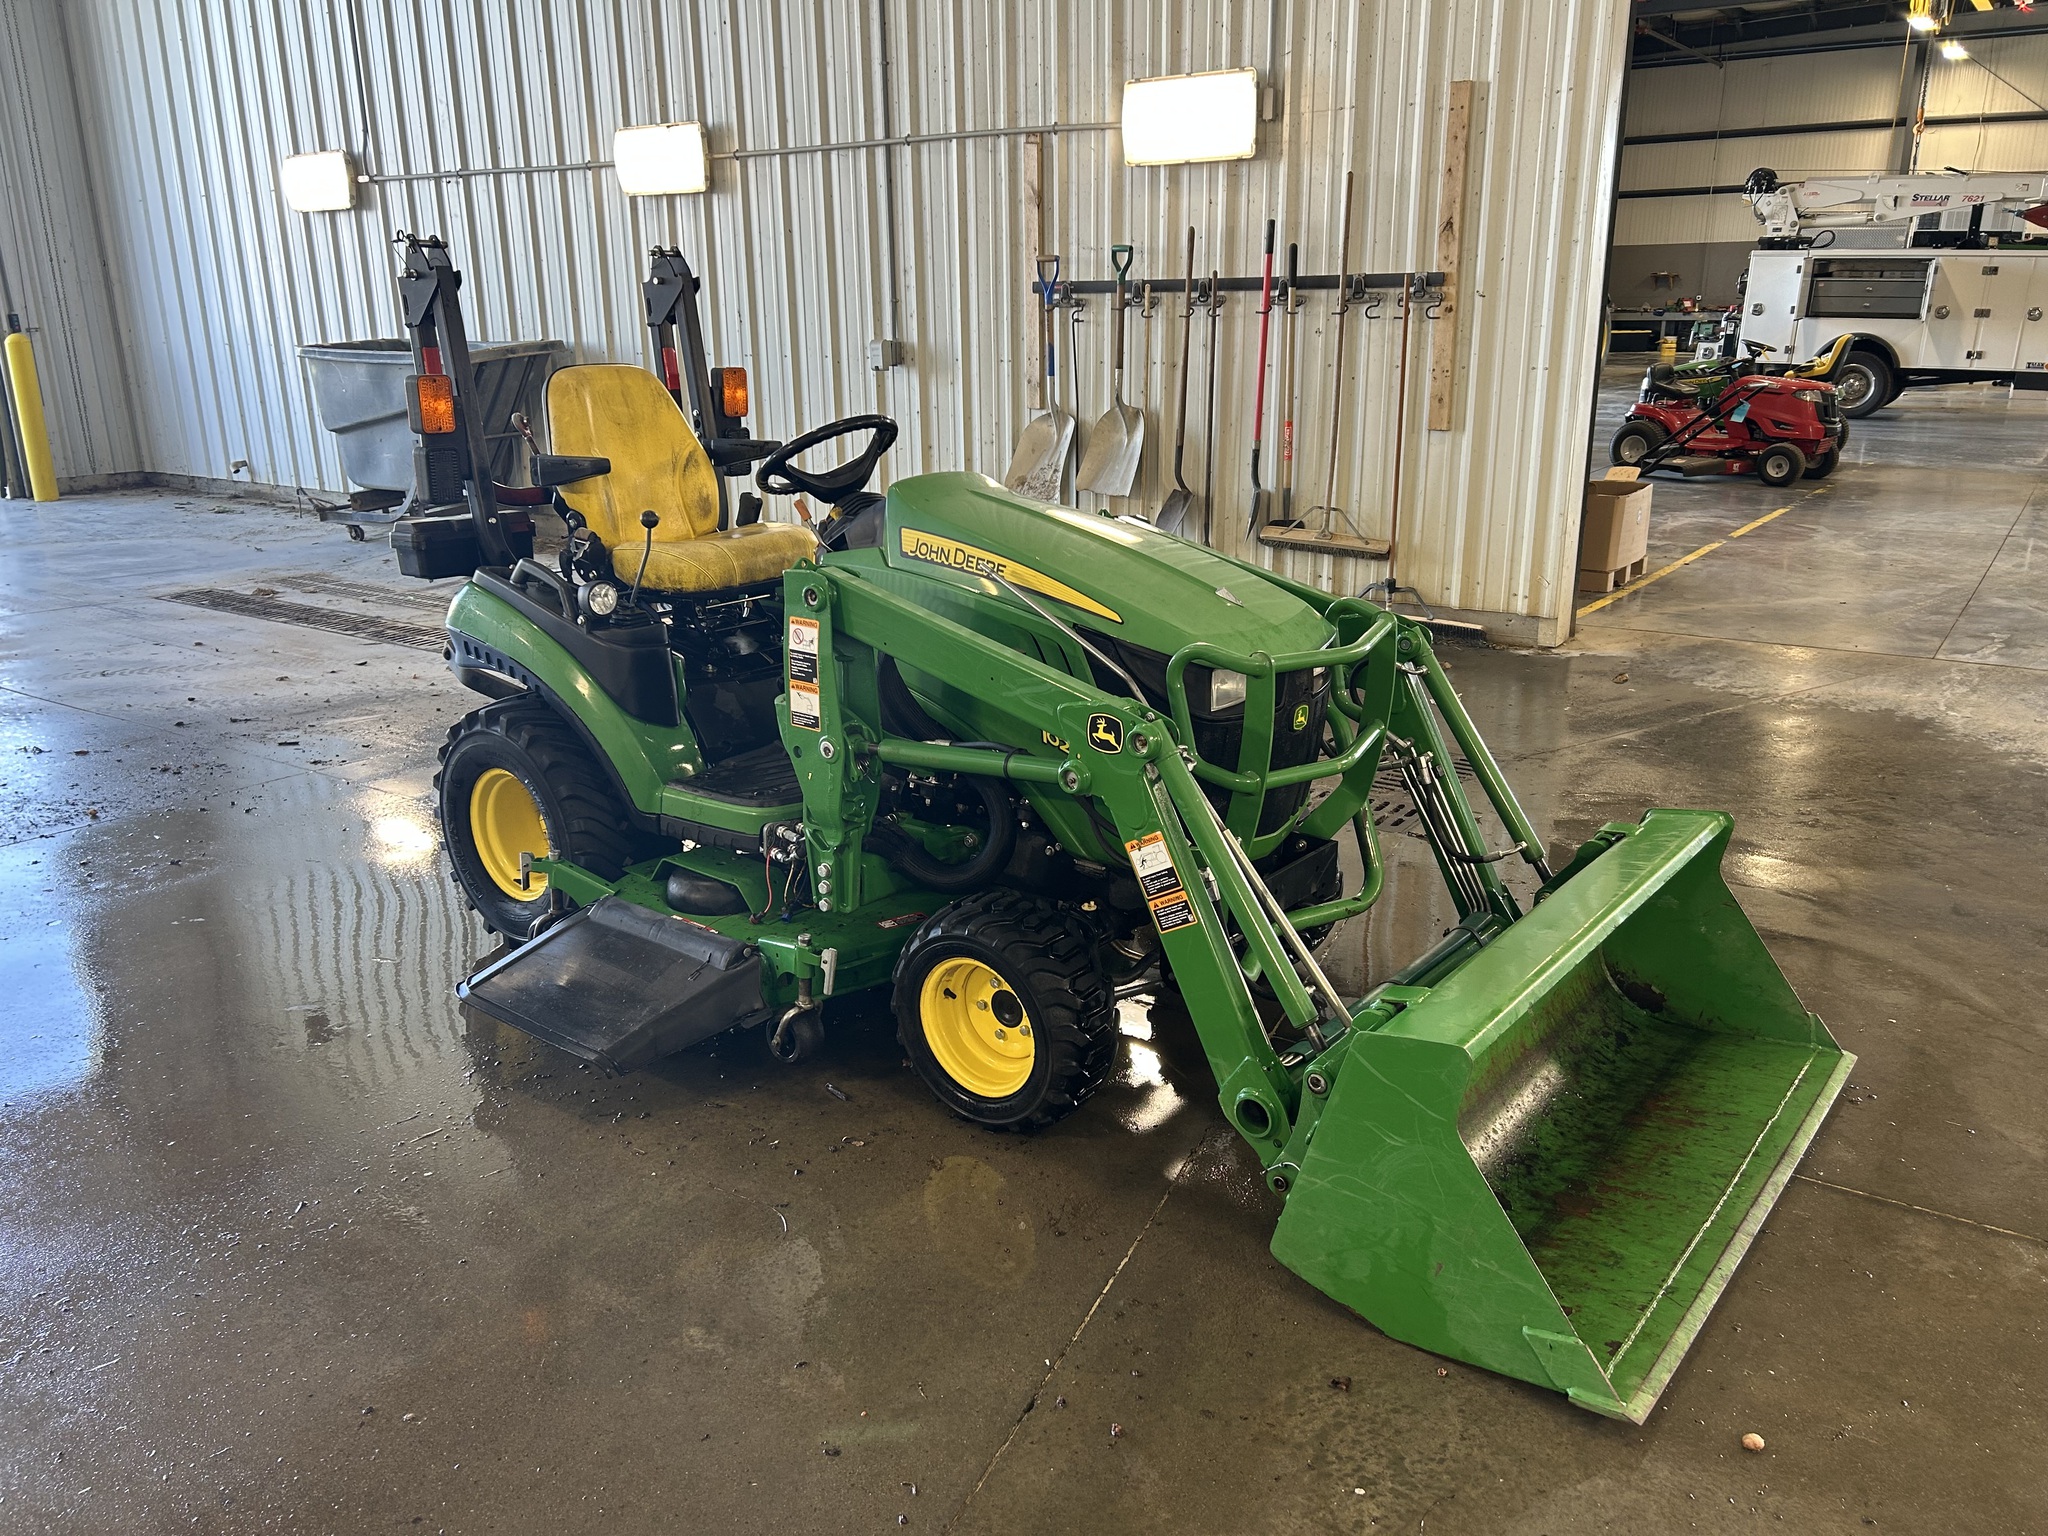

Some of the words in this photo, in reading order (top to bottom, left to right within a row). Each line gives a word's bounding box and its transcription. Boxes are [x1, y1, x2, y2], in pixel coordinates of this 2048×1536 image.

[1911, 193, 1951, 202] STELLAR
[1961, 195, 1986, 203] 7621
[909, 538, 951, 563] JOHN
[795, 618, 818, 629] WARNING
[795, 684, 818, 694] WARNING
[1159, 894, 1184, 906] WARNING
